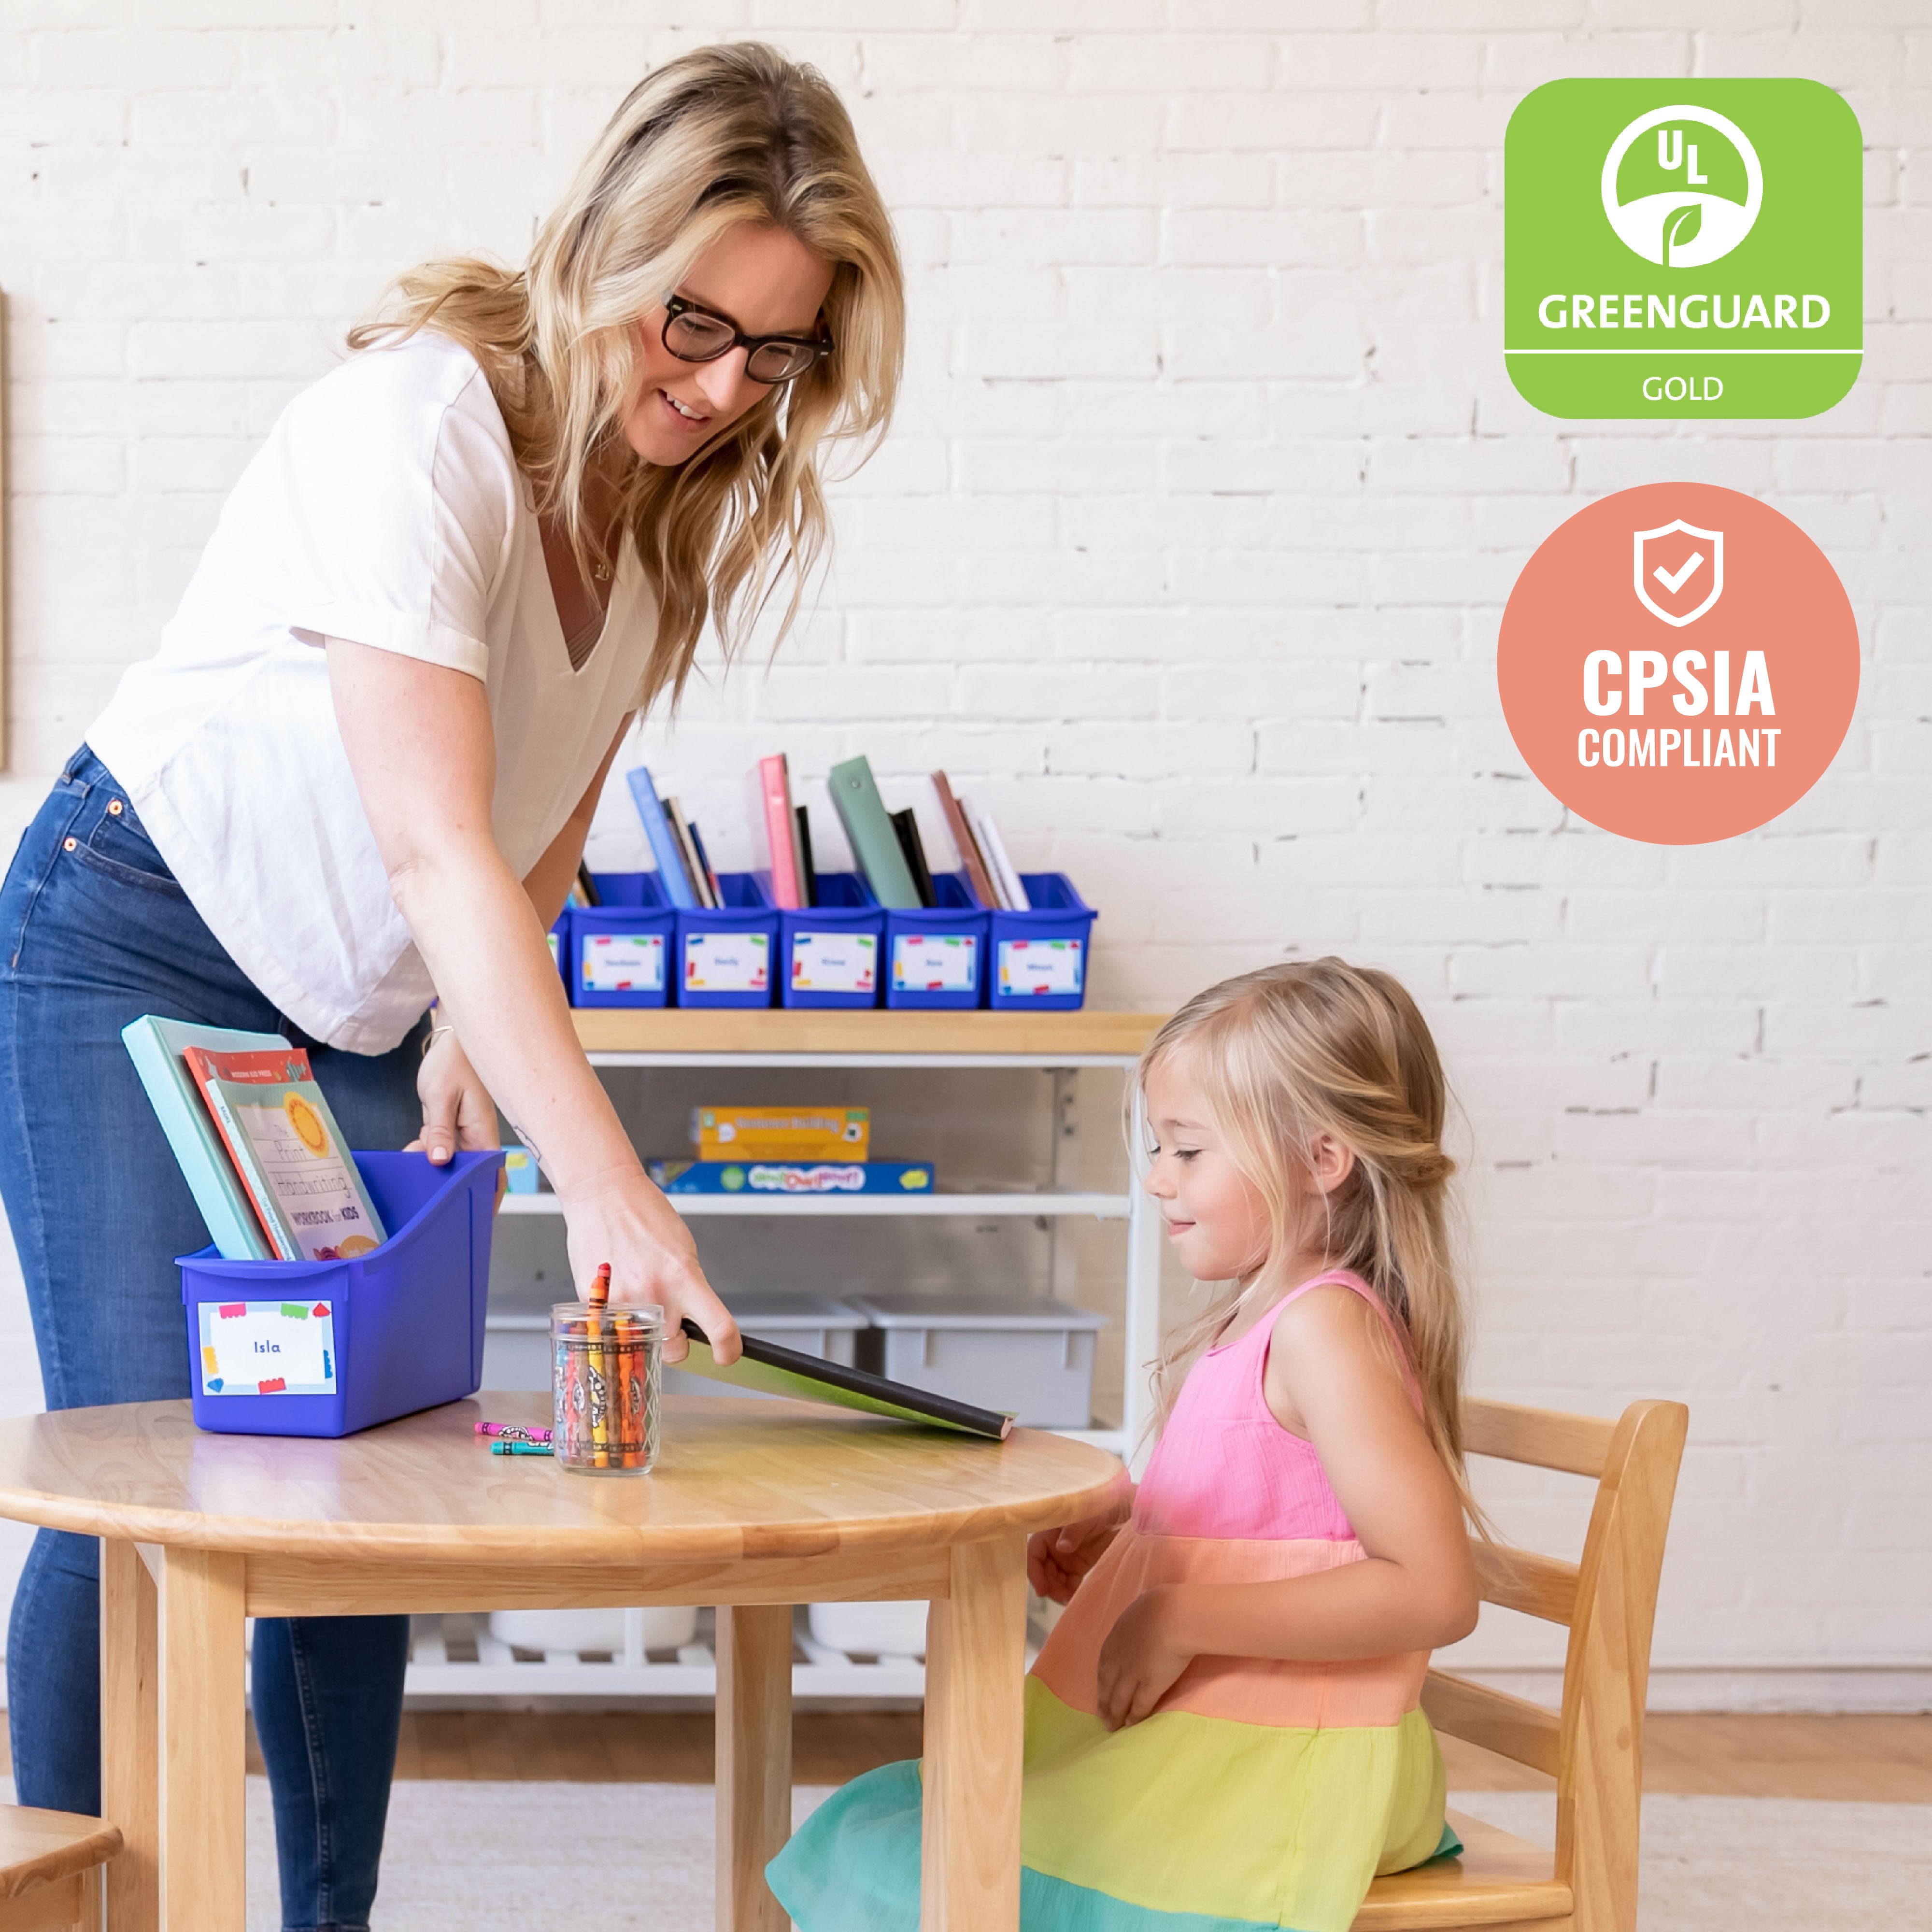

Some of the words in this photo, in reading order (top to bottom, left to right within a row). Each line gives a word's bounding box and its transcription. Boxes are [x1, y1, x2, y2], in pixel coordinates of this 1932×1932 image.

[791, 1116, 840, 1134] Building
[273, 1140, 307, 1162] Print
[271, 1171, 352, 1199] Handwriting
[290, 1210, 334, 1226] WORKBOOK
[340, 1206, 360, 1221] KIDS
[255, 1340, 280, 1352] Isla
